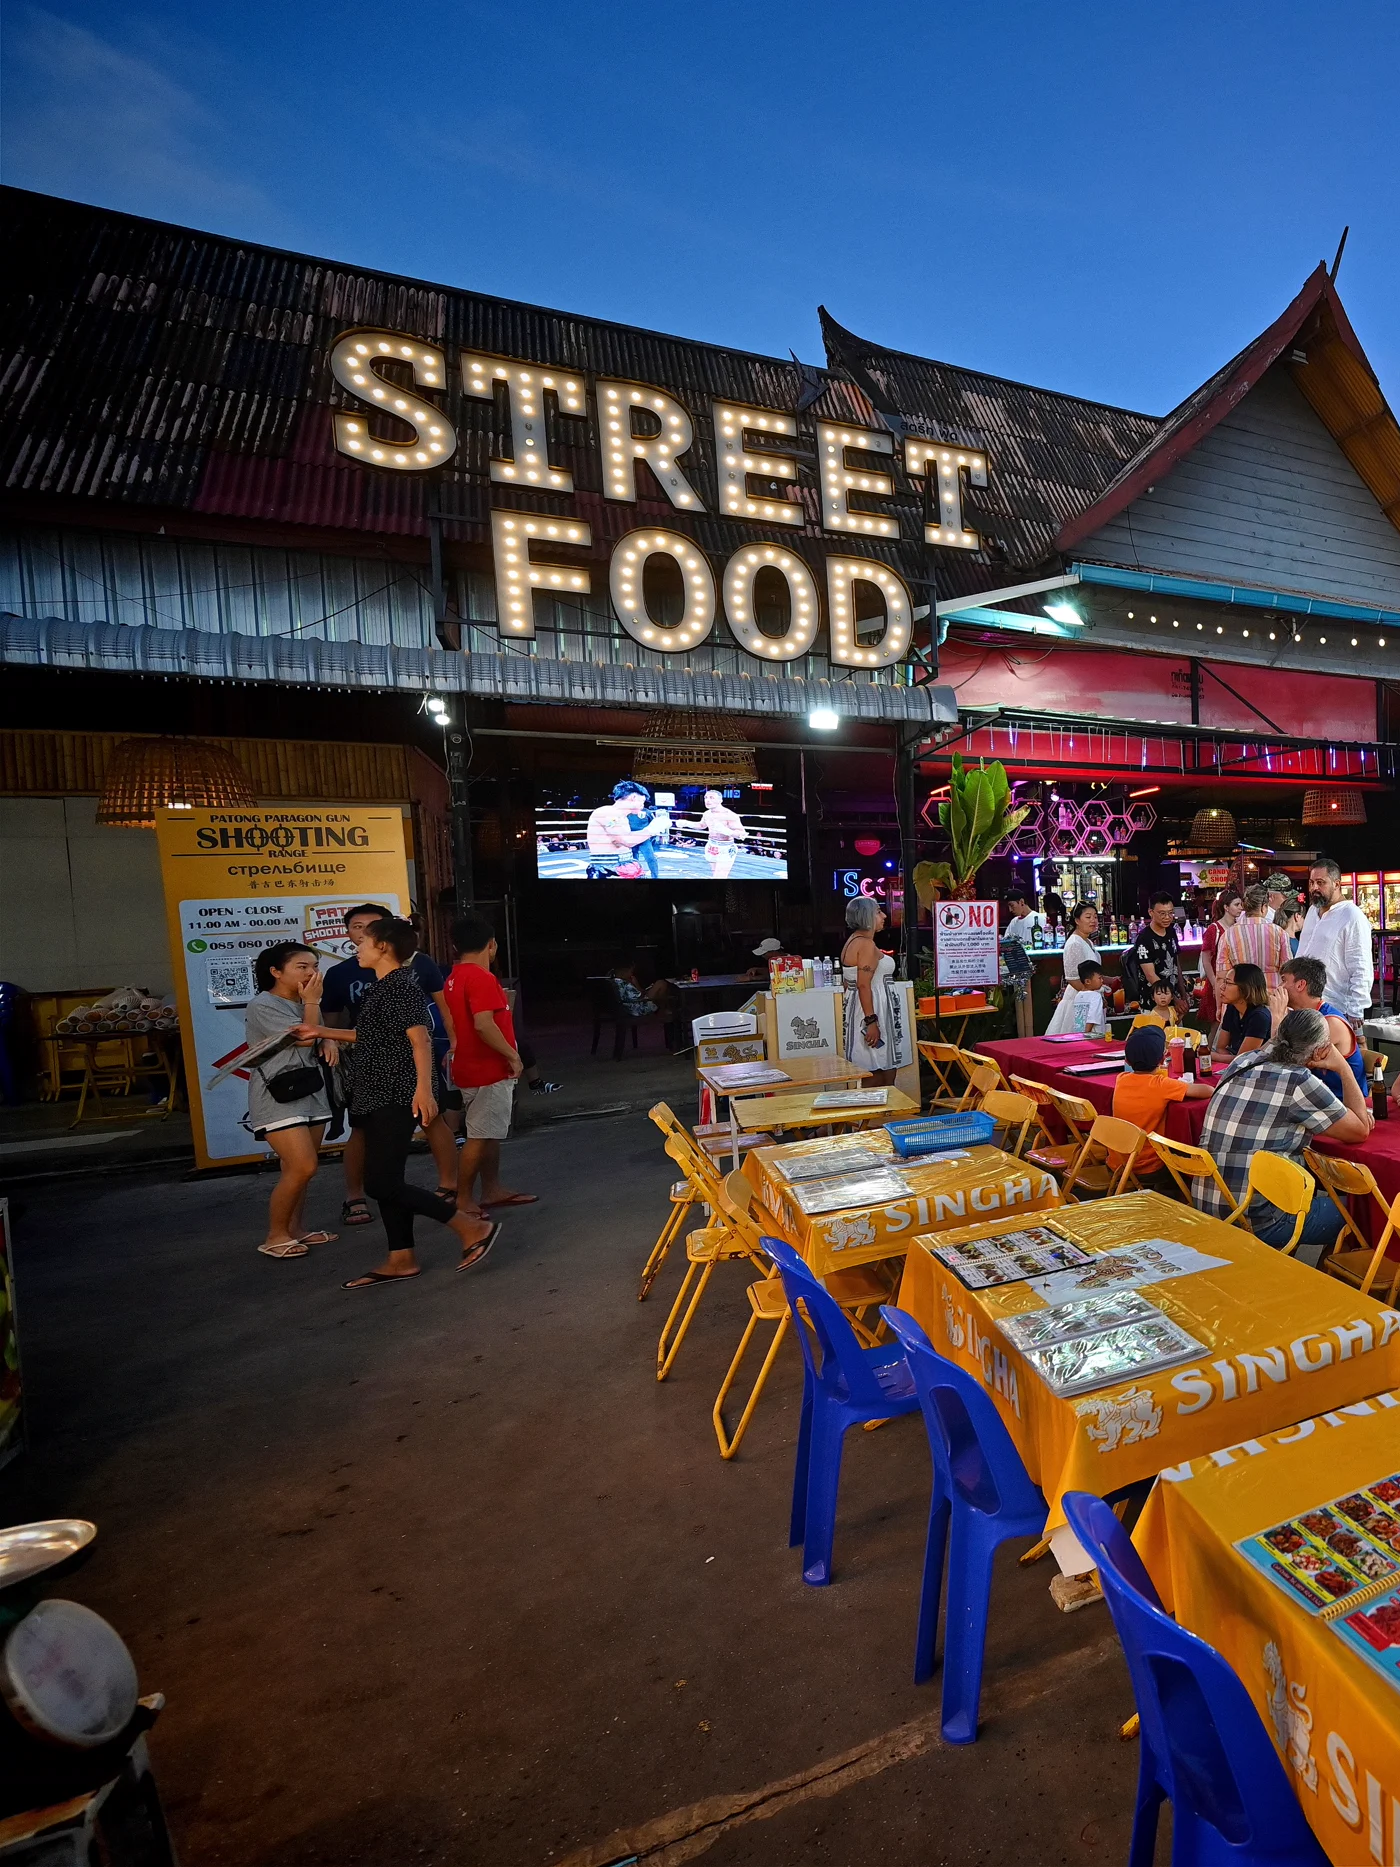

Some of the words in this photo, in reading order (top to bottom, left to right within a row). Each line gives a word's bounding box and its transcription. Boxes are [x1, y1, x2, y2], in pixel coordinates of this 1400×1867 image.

[330, 327, 989, 551] STREET
[490, 507, 914, 670] FOOD
[210, 814, 261, 823] PATONG
[265, 814, 322, 823] PARAGON
[326, 814, 350, 823] GUN
[196, 826, 369, 849] SHOOTING
[268, 850, 309, 858] RANGE
[228, 861, 347, 878] стрельбище
[199, 907, 234, 917] OPEN
[245, 905, 285, 915] CLOSE
[968, 905, 994, 927] NO
[188, 921, 221, 929] 11.00
[224, 920, 240, 928] AM
[249, 919, 281, 928] 00.00
[284, 917, 299, 926] AM
[209, 941, 235, 951] 085
[238, 940, 263, 950] 080
[786, 1038, 829, 1051] SINGHA
[885, 1173, 1060, 1234] SINGHA
